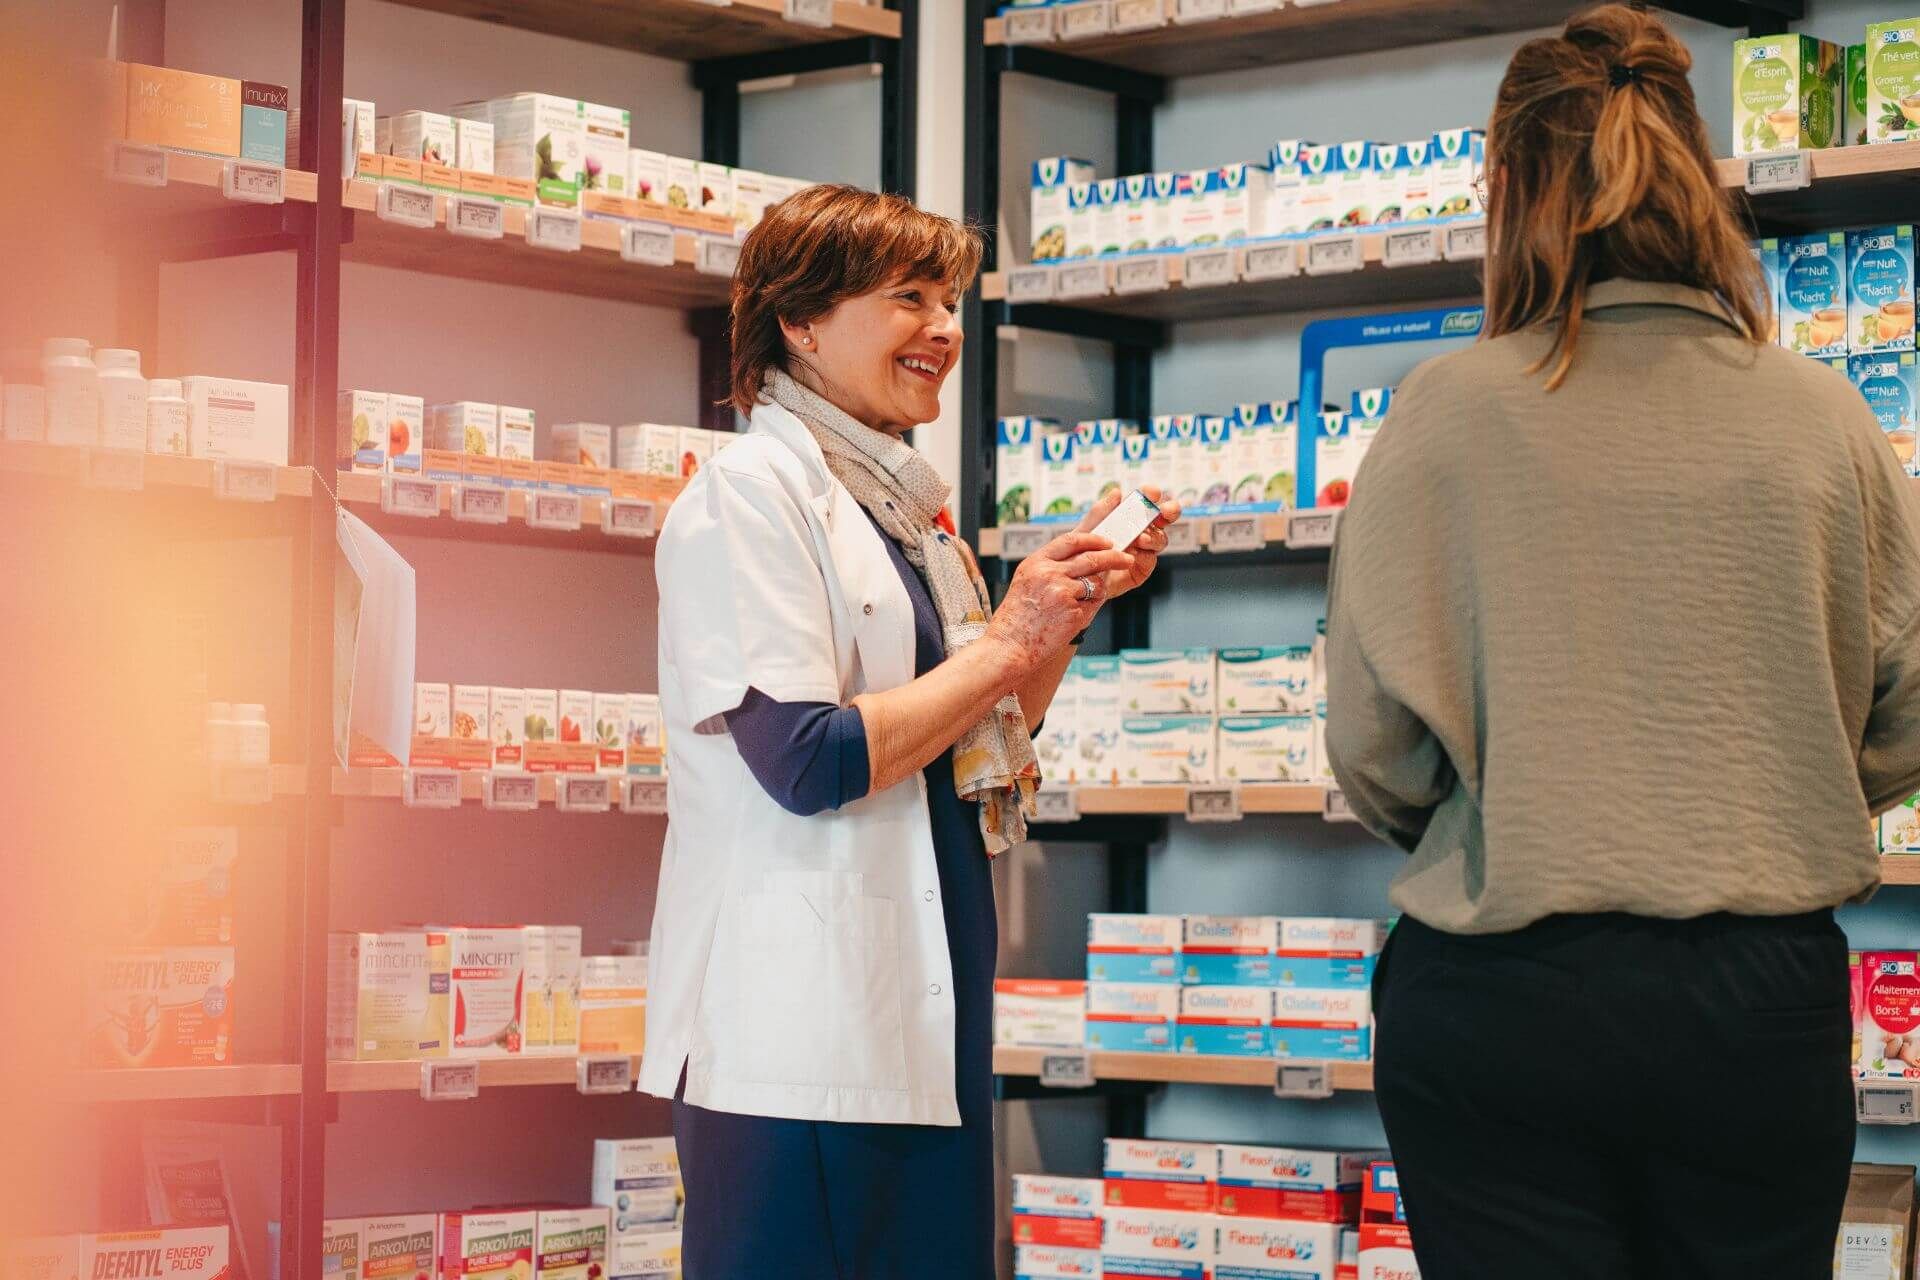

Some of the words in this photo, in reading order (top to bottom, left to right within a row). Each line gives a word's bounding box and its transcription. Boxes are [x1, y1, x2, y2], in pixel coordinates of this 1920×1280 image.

[1877, 258, 1897, 269] Nuit
[1809, 265, 1829, 276] Nuit
[1867, 284, 1893, 297] Nacht
[1799, 291, 1826, 303] Nacht
[1879, 386, 1899, 397] Nuit
[1876, 412, 1895, 424] acht
[461, 953, 515, 966] MINCIFIT
[173, 961, 221, 973] ENERGY
[178, 973, 210, 985] PLUS
[1875, 1005, 1902, 1017] Borst-
[166, 1245, 215, 1260] ENERGY
[371, 1236, 432, 1258] ARKOVITAL
[92, 1248, 163, 1280] DEFATYL
[172, 1258, 203, 1272] PLUS
